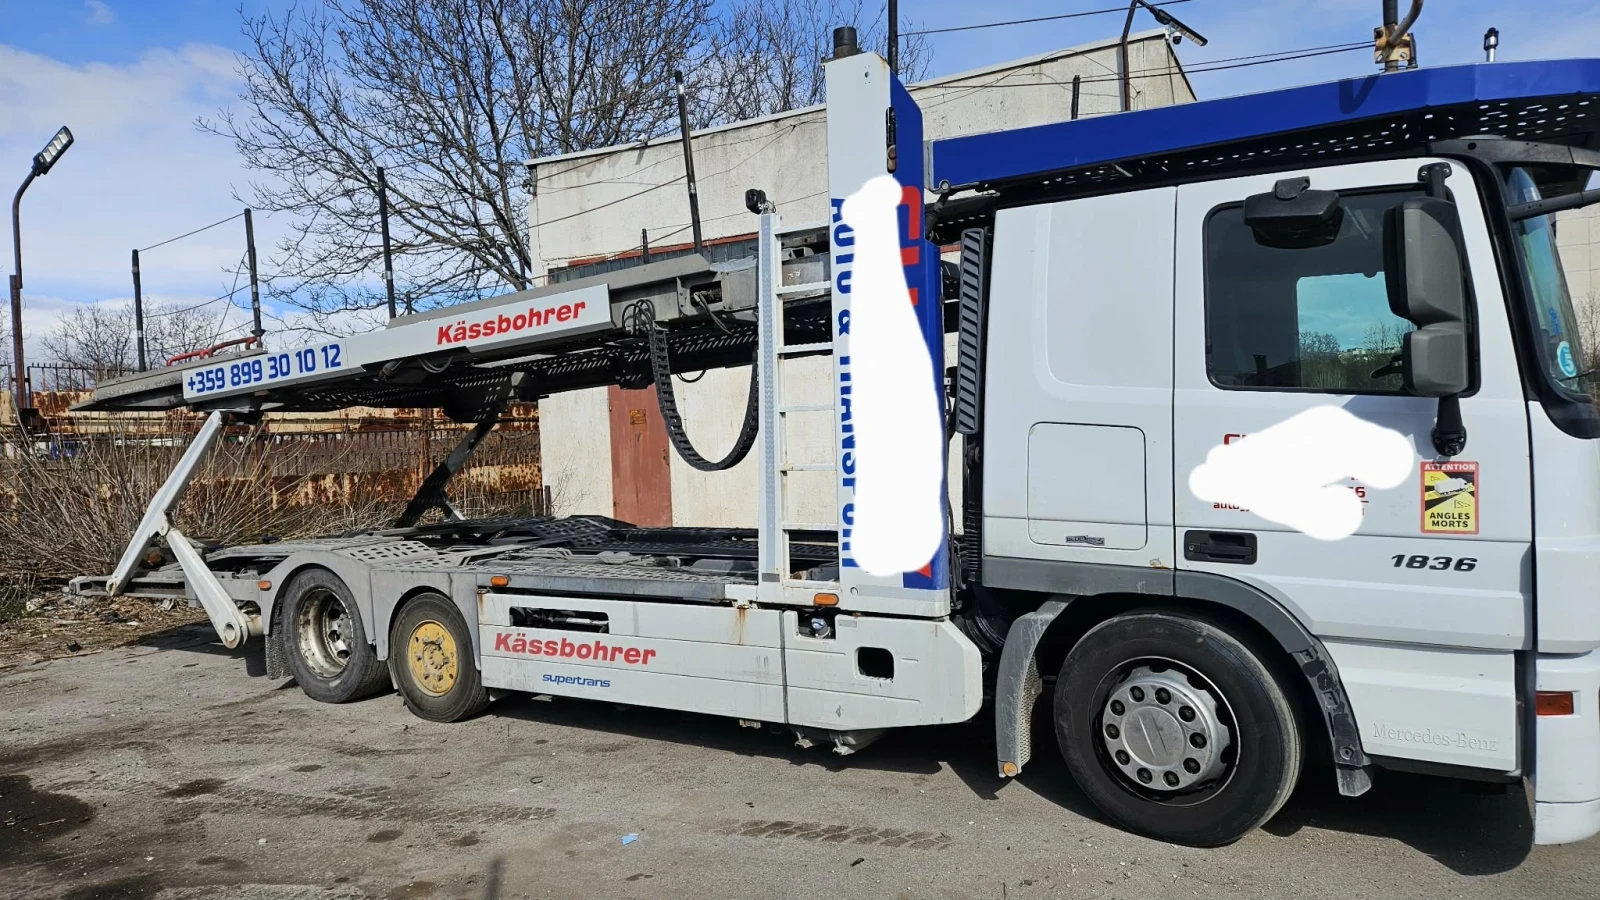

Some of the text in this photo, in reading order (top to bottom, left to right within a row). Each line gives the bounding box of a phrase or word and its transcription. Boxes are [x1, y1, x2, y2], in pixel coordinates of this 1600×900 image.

[437, 301, 586, 345] Kässbohrer
[187, 343, 342, 393] +359 899 30 10 12
[1424, 463, 1476, 471] ATTENTION
[1429, 512, 1471, 520] ANGLES
[1431, 520, 1469, 528] MORTS
[1391, 553, 1478, 572] 1836
[494, 632, 656, 664] Kässbohrer
[542, 673, 611, 687] supertrans
[1373, 723, 1498, 751] Mercedes-Benz
